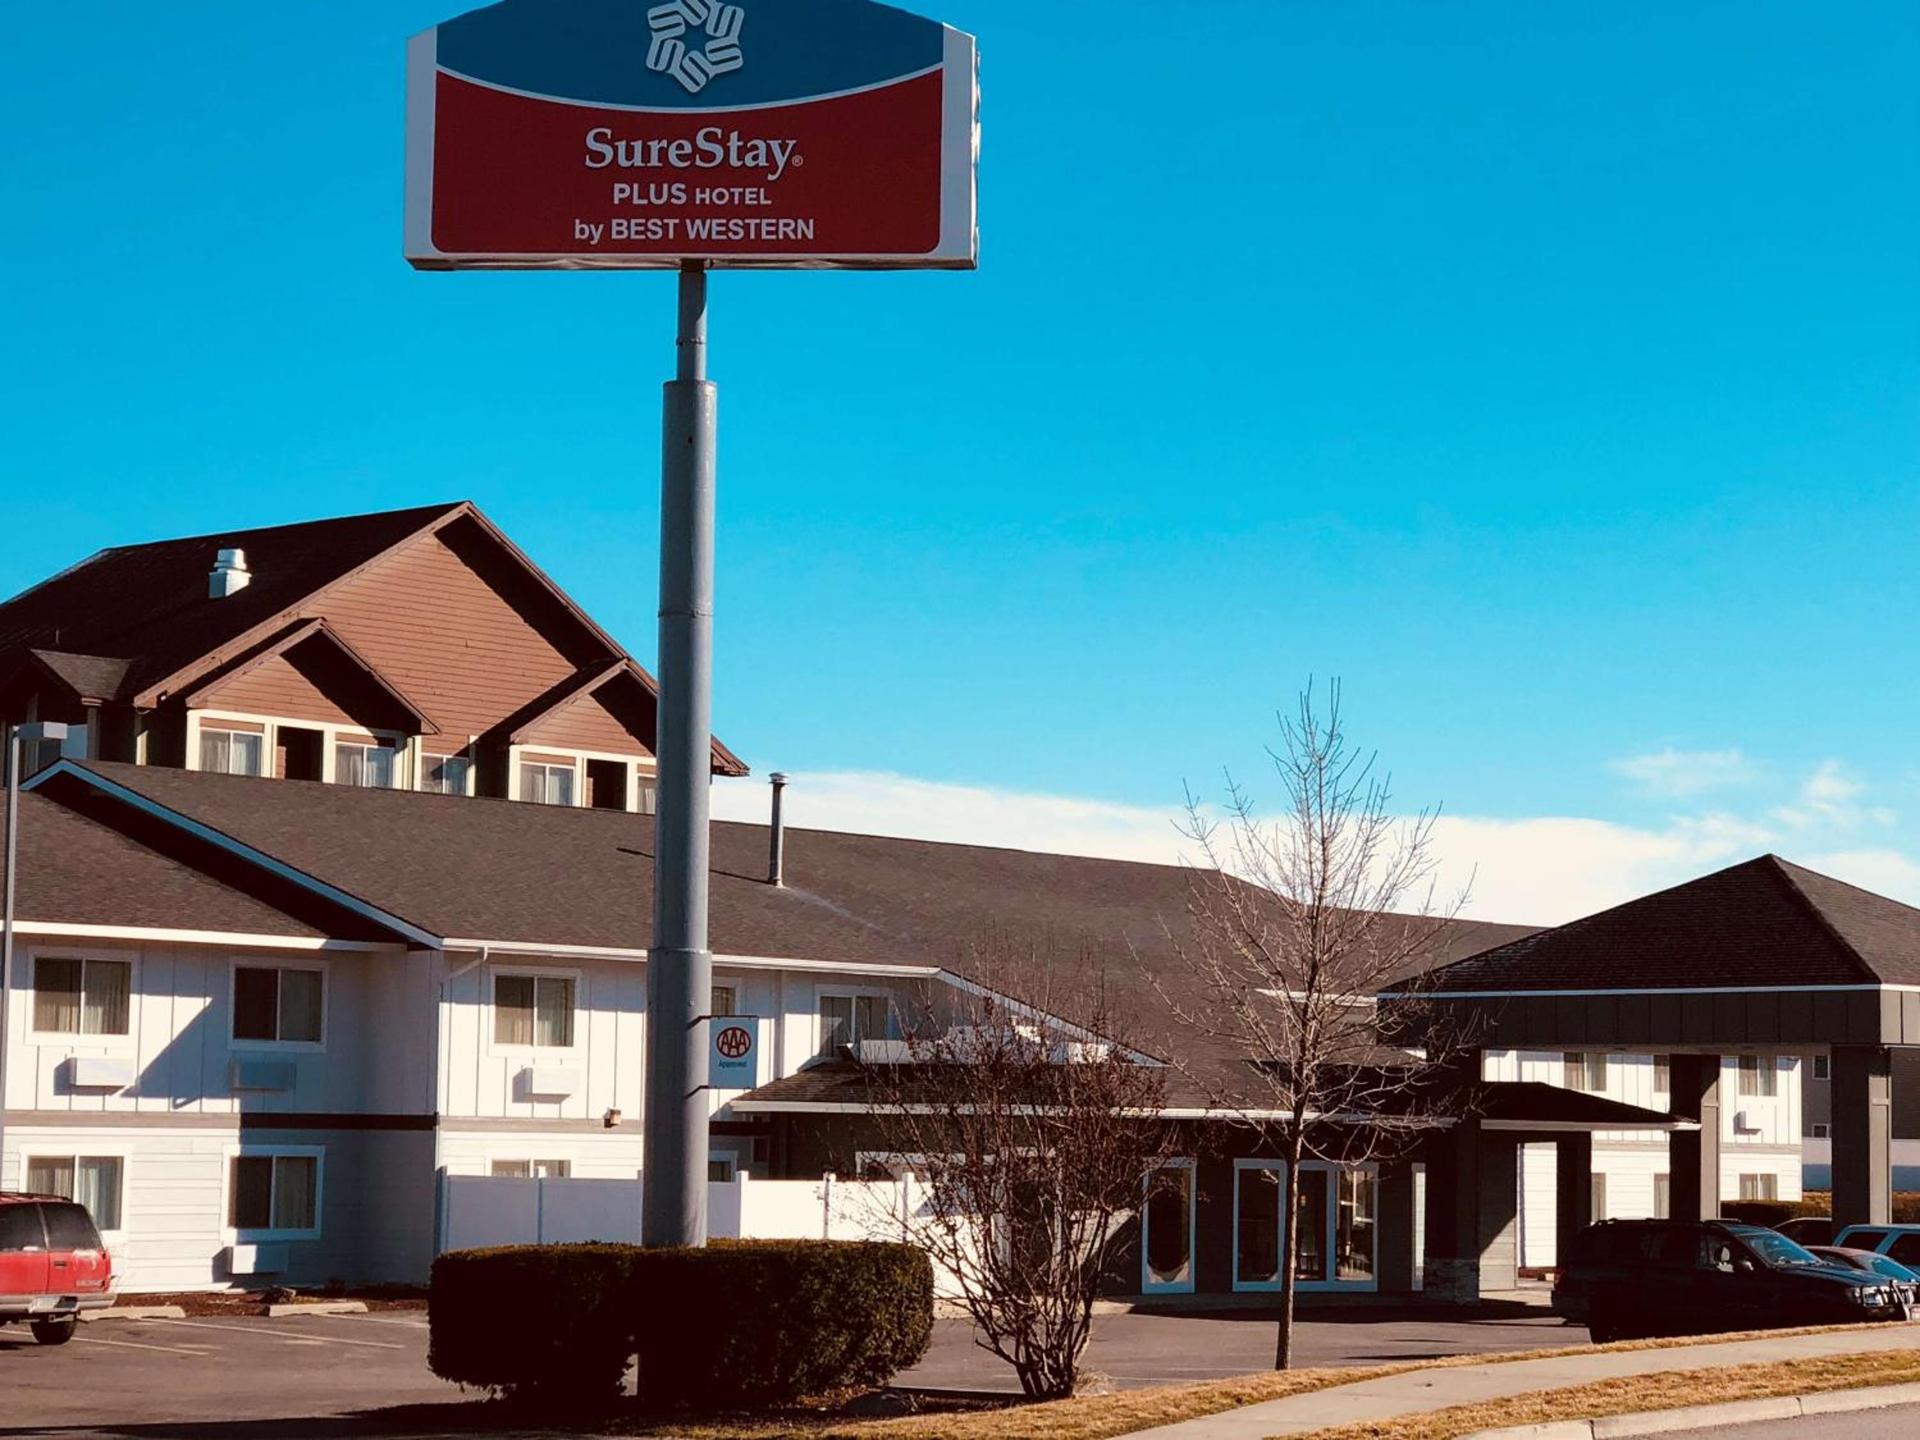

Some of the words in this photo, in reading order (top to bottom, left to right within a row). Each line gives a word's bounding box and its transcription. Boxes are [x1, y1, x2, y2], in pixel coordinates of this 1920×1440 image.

[613, 183, 687, 204] PLUS
[695, 187, 772, 204] HOTEL
[574, 219, 603, 245] by
[611, 219, 679, 239] BEST
[686, 219, 814, 239] WESTERN
[720, 1029, 747, 1056] AAA
